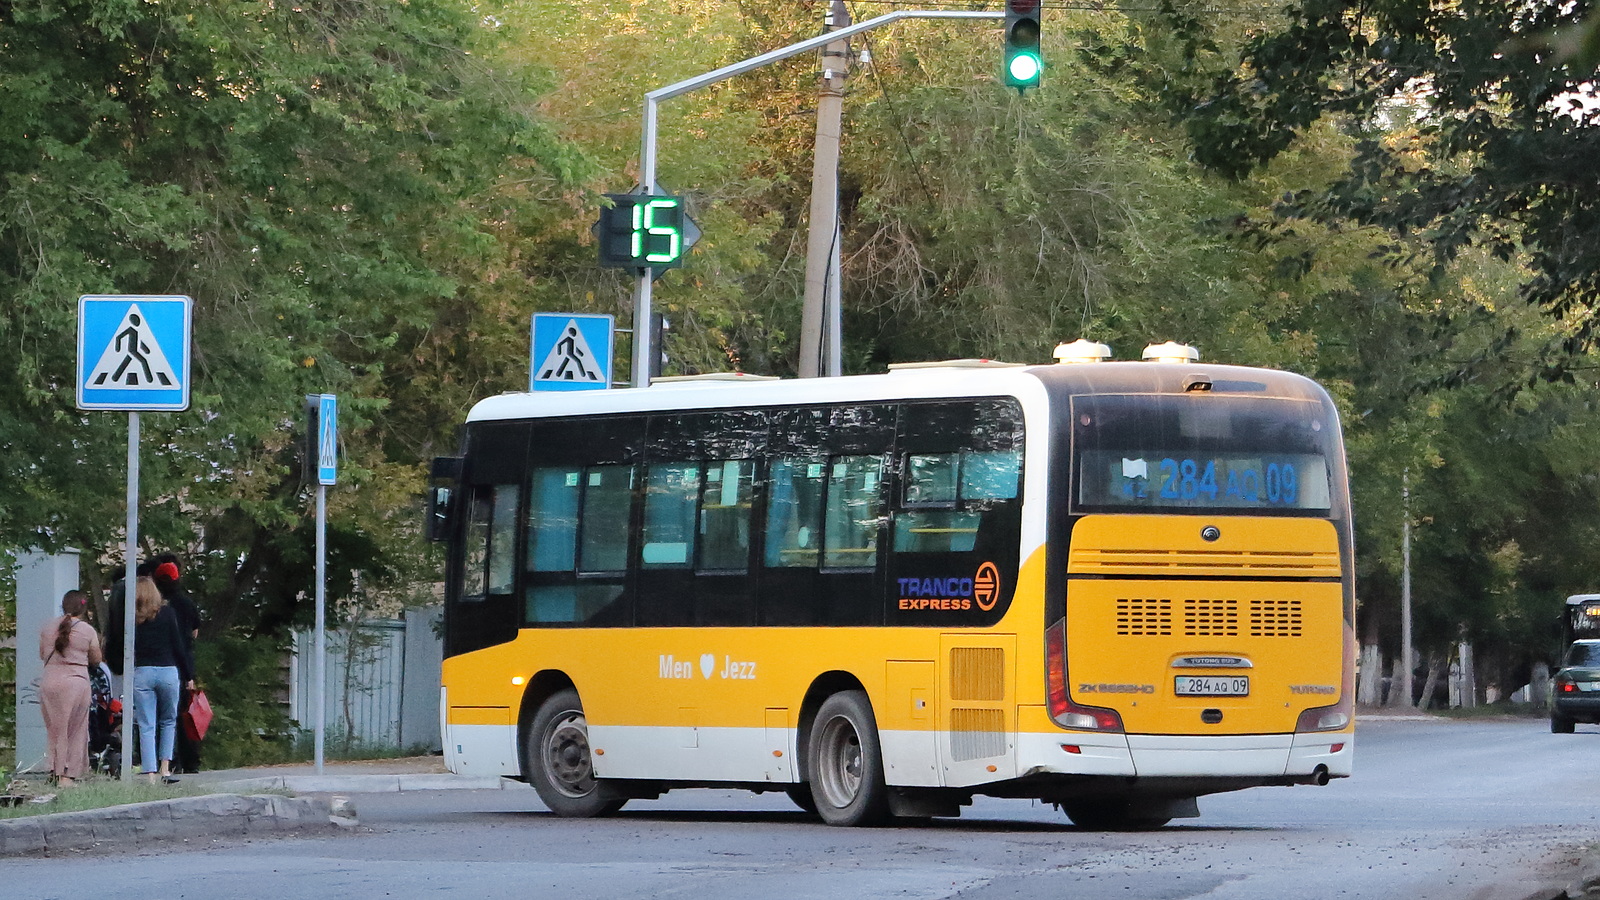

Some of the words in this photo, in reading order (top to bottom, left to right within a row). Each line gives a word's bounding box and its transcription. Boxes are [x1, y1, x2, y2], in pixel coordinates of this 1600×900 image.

[631, 199, 679, 262] 15
[1160, 457, 1218, 500] 284
[1266, 462, 1297, 504] 09
[897, 577, 973, 597] TRANCO
[898, 599, 972, 610] EXPRESS
[659, 654, 692, 679] Men
[720, 654, 756, 679] Jezz
[1188, 679, 1211, 692] 284
[1213, 682, 1228, 693] AQ
[1232, 679, 1247, 693] 09
